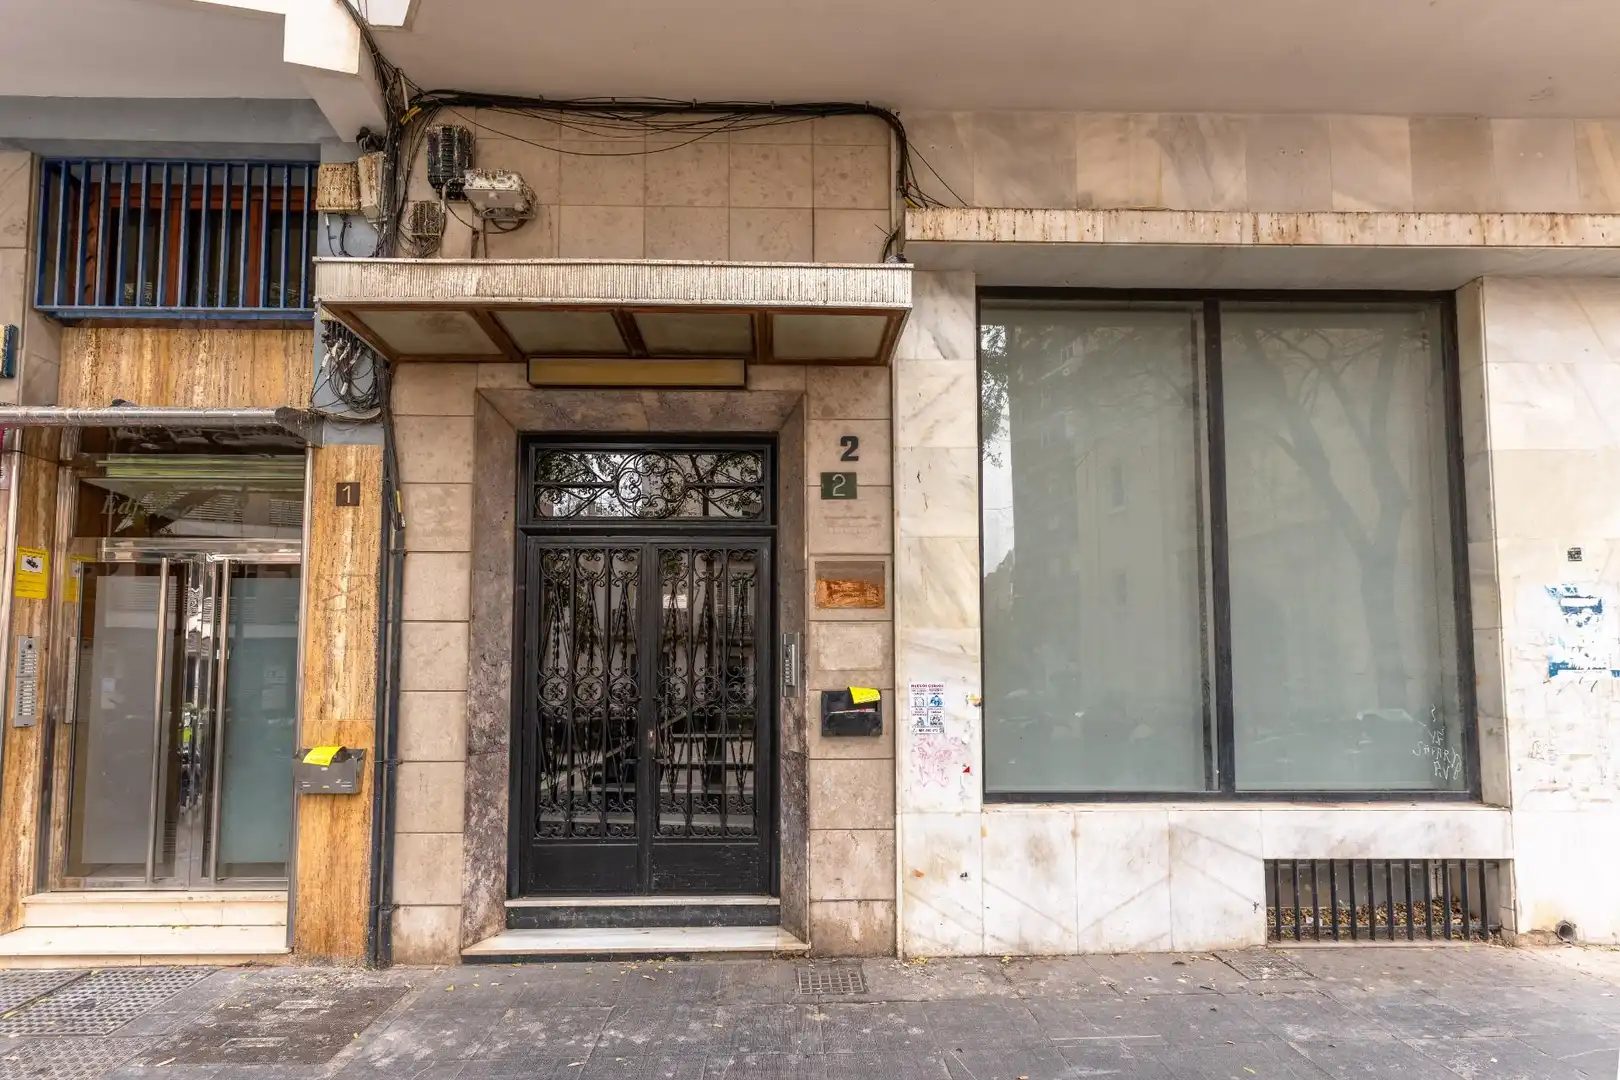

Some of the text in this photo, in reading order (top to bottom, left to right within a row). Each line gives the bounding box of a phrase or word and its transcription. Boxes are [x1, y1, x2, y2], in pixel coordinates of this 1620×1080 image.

[840, 436, 859, 461] 2
[342, 485, 351, 503] 1
[832, 474, 846, 496] 2
